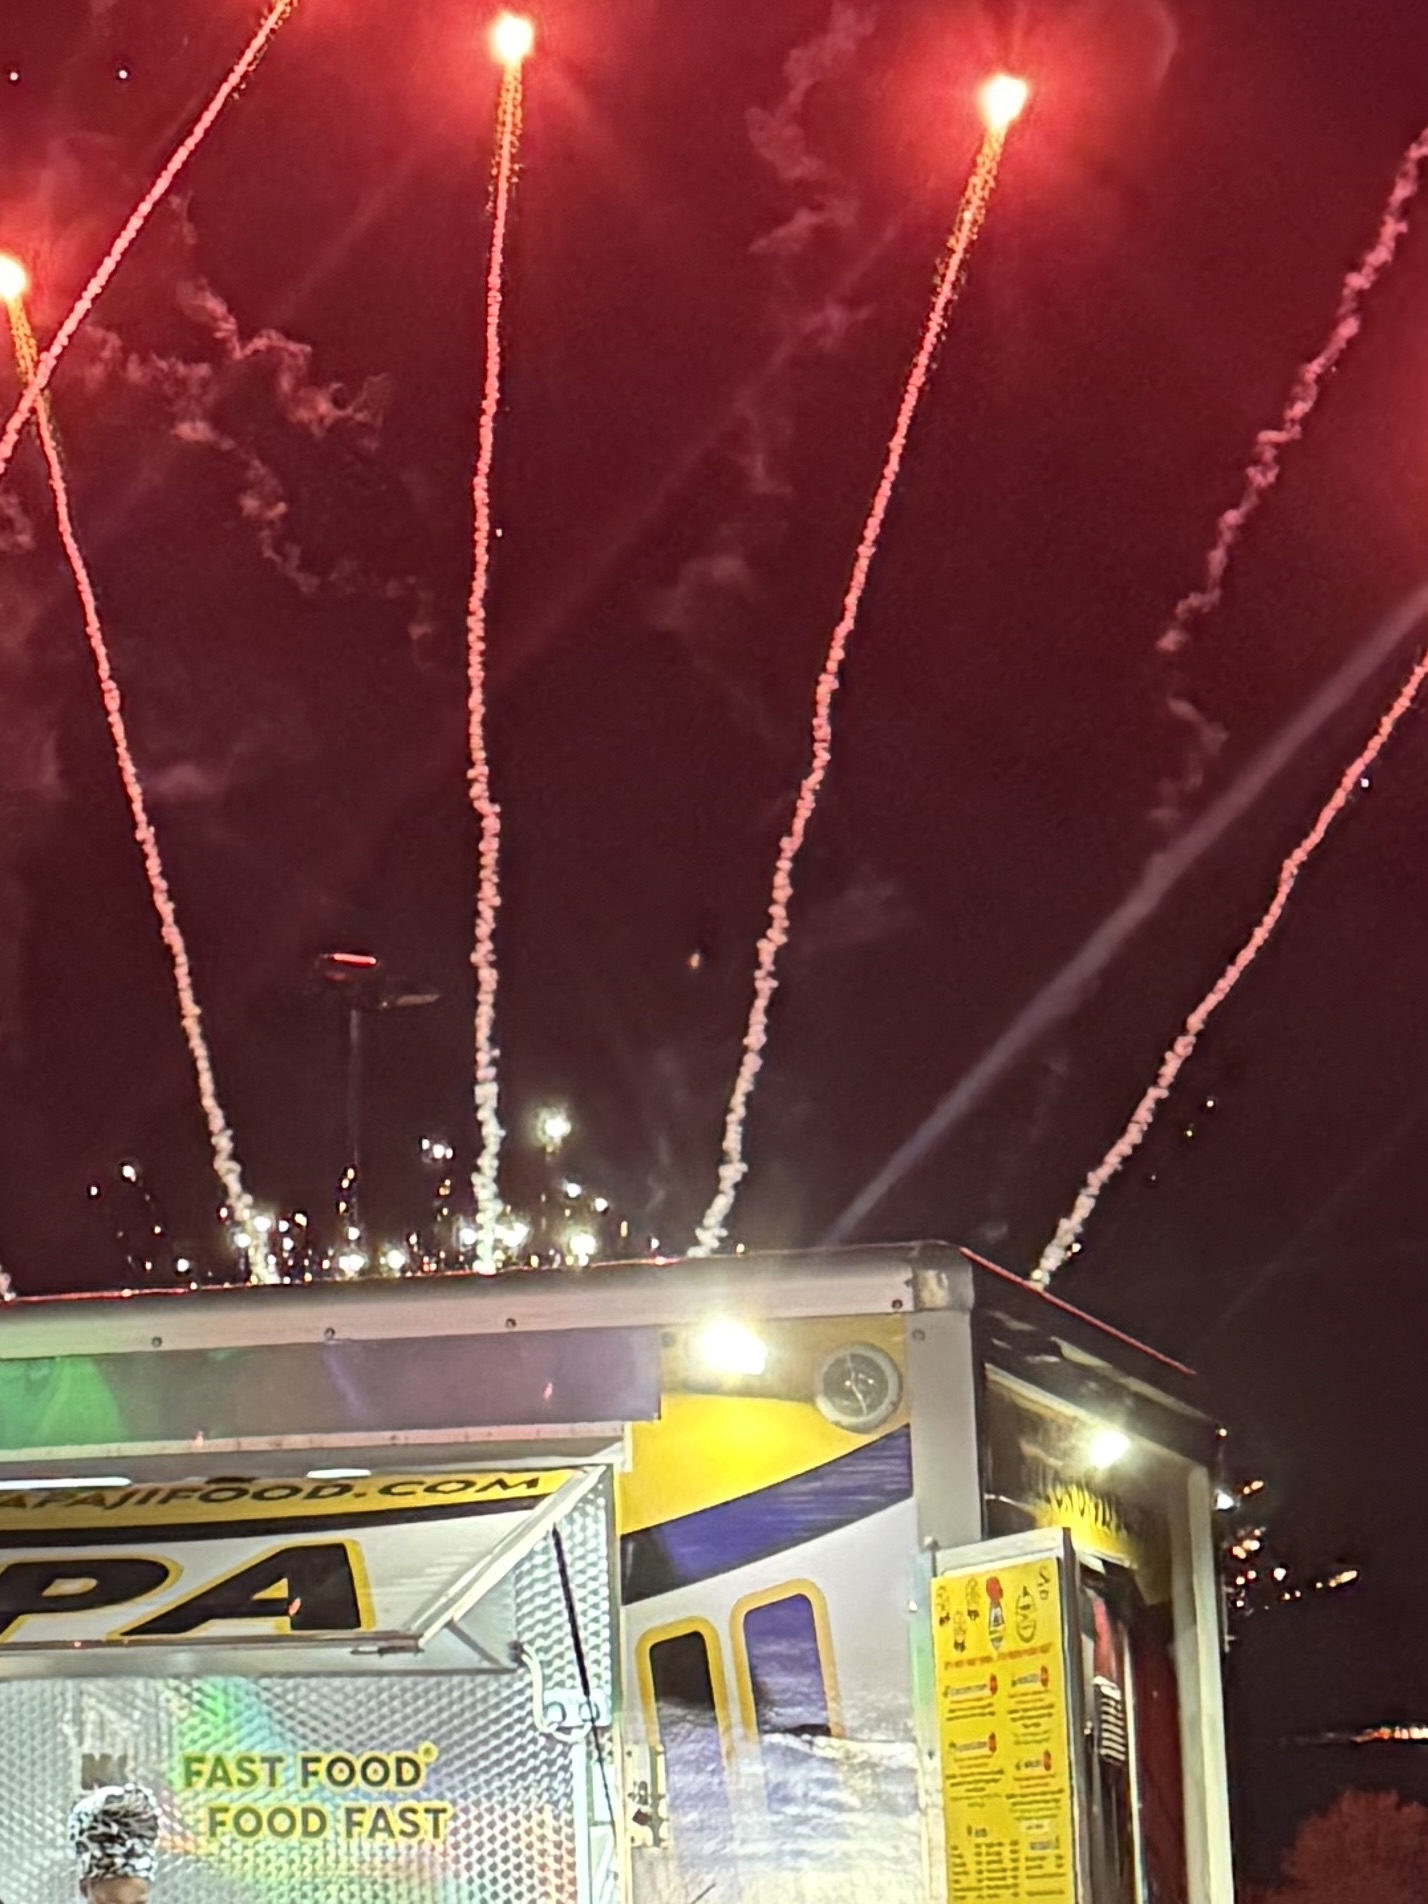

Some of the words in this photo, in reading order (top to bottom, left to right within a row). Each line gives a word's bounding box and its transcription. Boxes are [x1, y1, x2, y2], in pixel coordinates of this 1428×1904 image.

[183, 1754, 286, 1788] FAST
[300, 1754, 422, 1788] FOOD
[207, 1805, 328, 1839] FOOD
[344, 1805, 448, 1839] FAST
